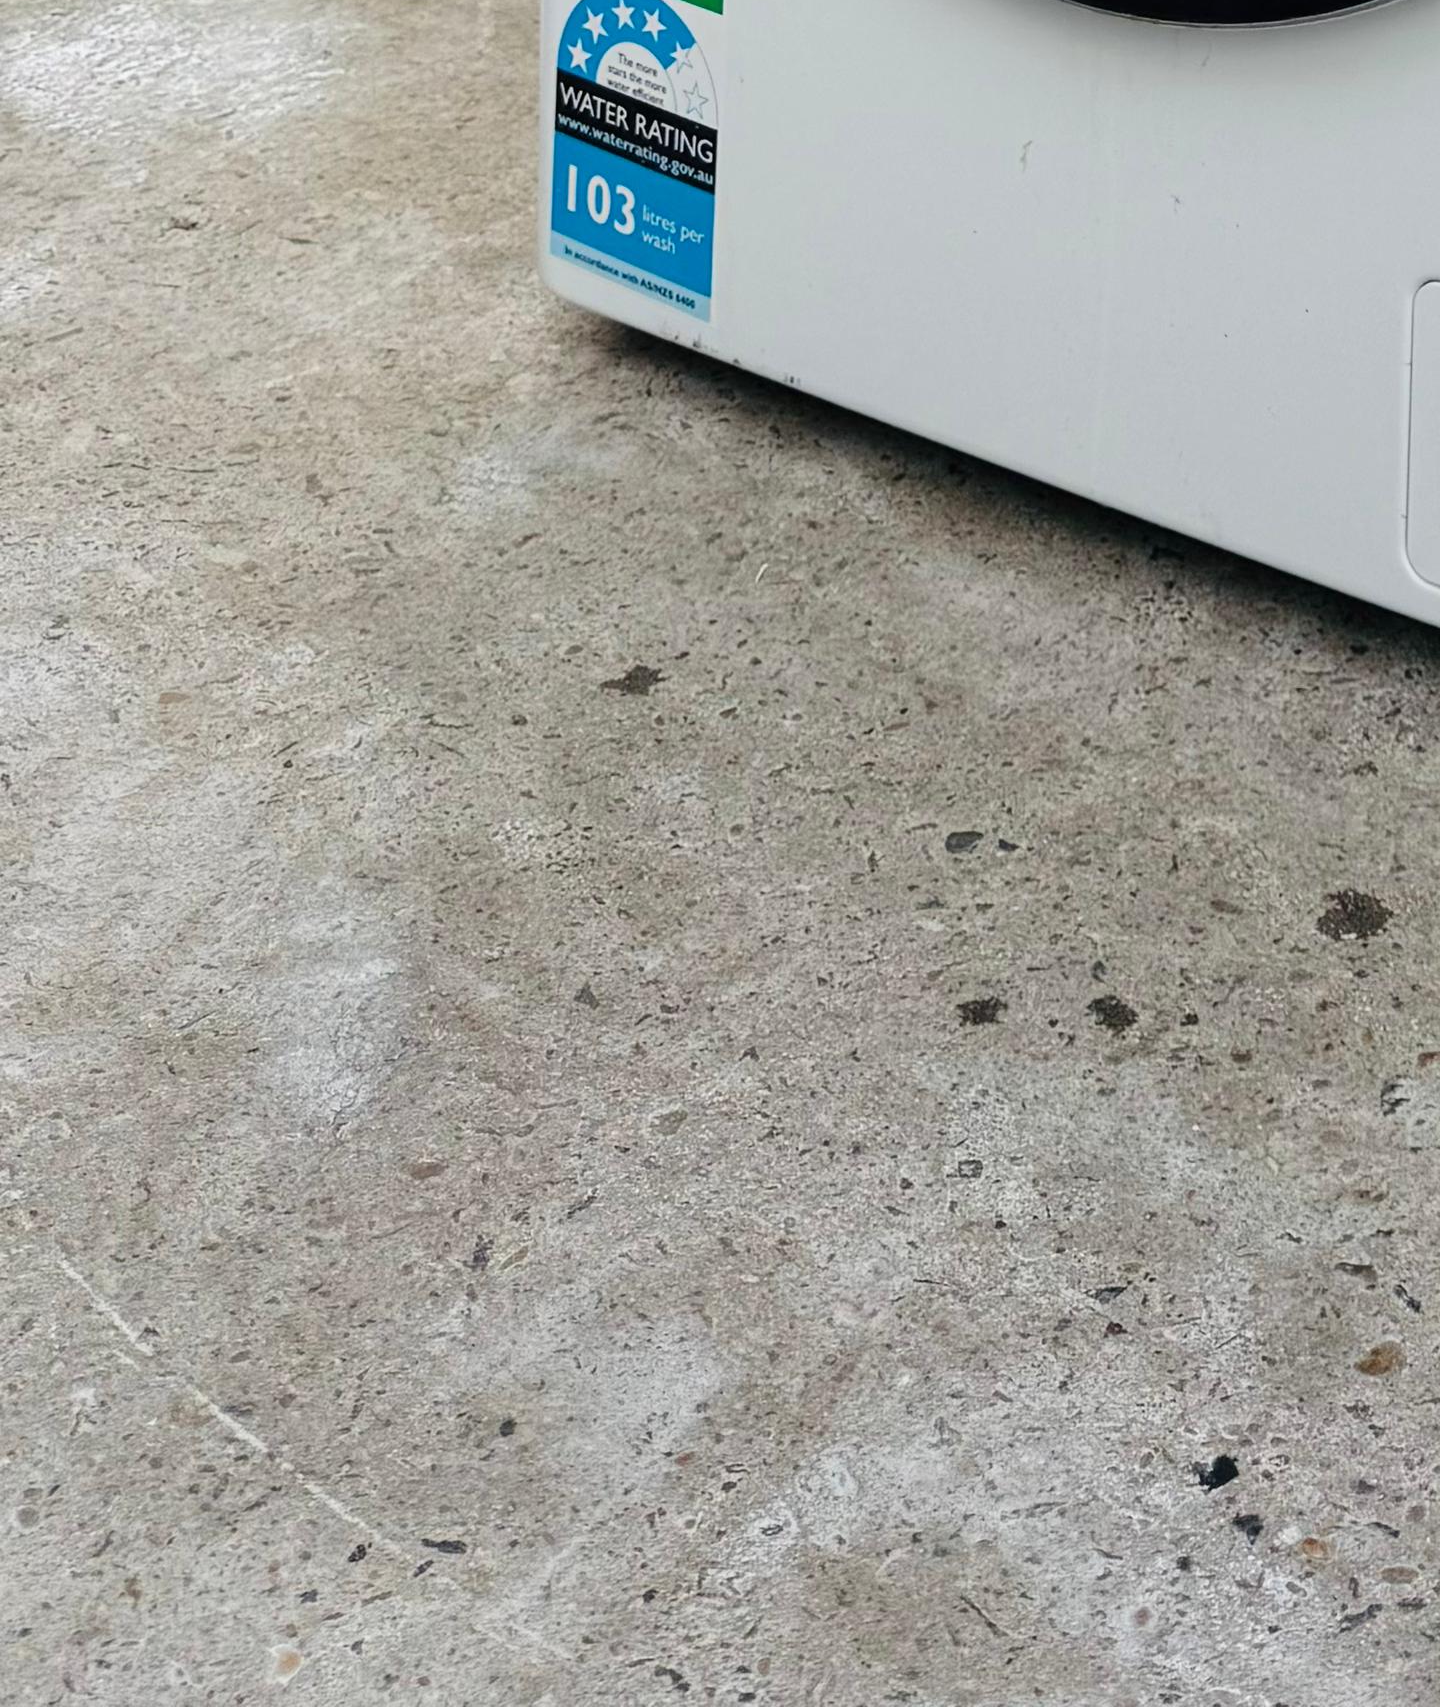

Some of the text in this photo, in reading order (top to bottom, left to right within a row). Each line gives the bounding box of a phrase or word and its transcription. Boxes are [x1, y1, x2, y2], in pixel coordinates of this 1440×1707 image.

[608, 65, 667, 94] stars the more
[618, 52, 658, 78] The more
[607, 78, 665, 106] water efficient
[559, 81, 714, 164] WATER RATING
[557, 113, 714, 186] www.waterrating.gov.au
[567, 164, 636, 236] 103
[642, 203, 705, 244] litres per
[641, 230, 676, 255] wash
[574, 251, 619, 277] accordance
